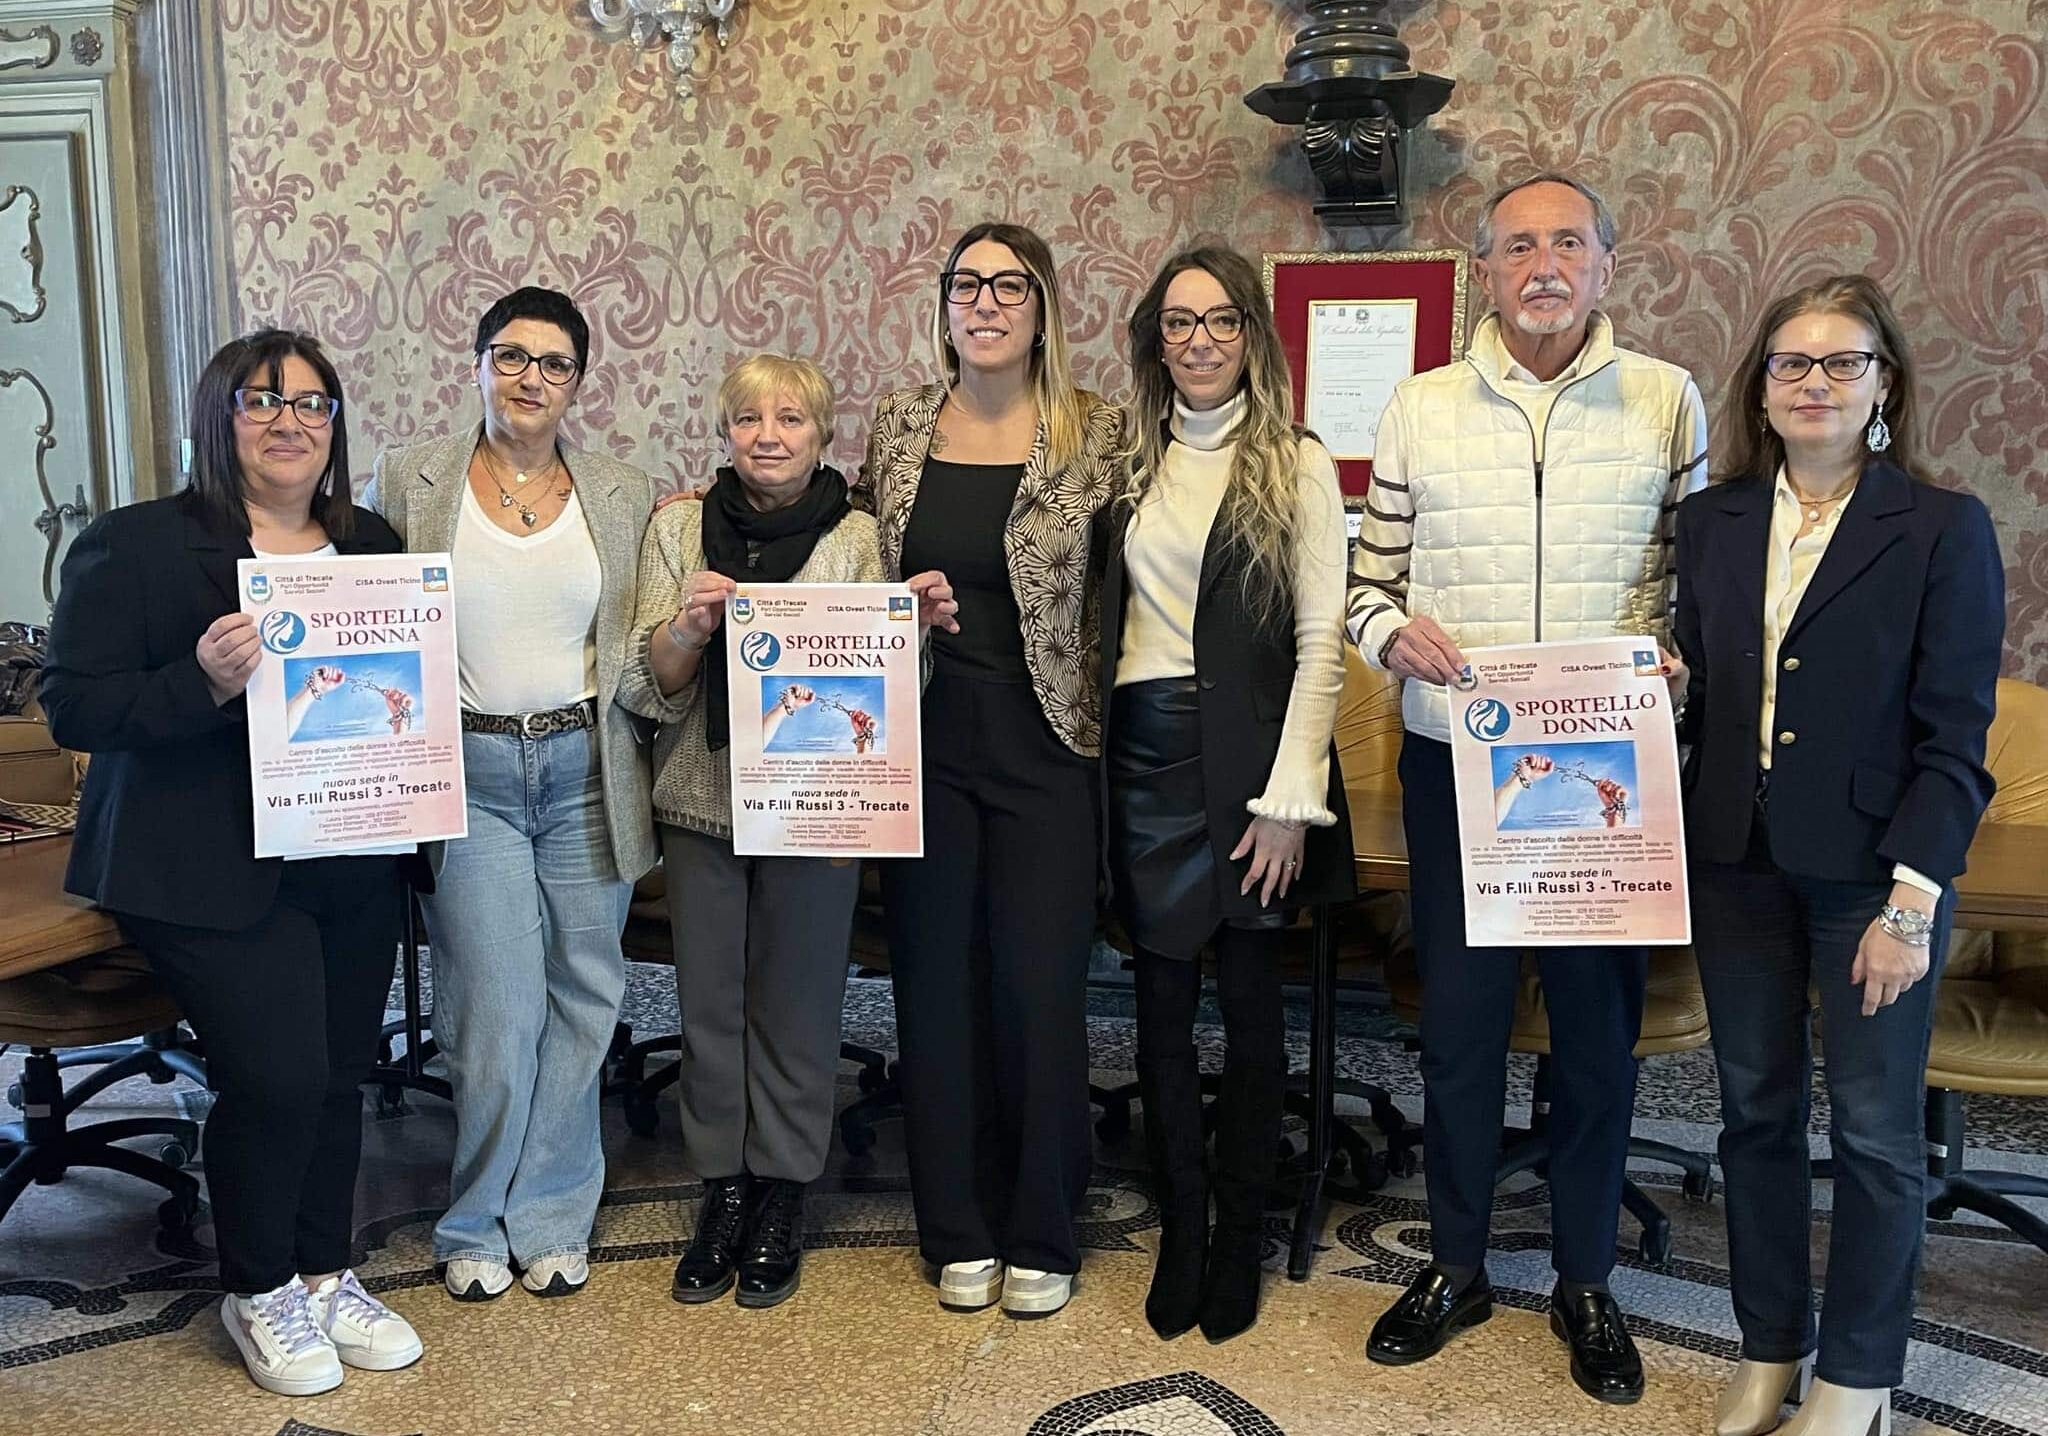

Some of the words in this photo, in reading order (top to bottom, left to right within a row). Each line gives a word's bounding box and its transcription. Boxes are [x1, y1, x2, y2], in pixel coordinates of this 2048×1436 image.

[310, 606, 442, 628] SPORTELLO
[336, 627, 420, 646] DONNA
[785, 635, 906, 650] SPORTELLO
[808, 653, 886, 668] DONNA
[1515, 692, 1657, 717] SPORTELLO
[1542, 716, 1634, 735] DONNA
[322, 778, 357, 789] nuova
[359, 774, 386, 786] sede
[388, 772, 399, 782] in
[267, 795, 292, 808] Via
[328, 787, 370, 802] Russi
[374, 786, 383, 798] 3
[397, 780, 452, 796] Trecate
[792, 790, 822, 798] nuova
[824, 789, 848, 798] sede
[850, 789, 860, 798] in
[743, 800, 764, 810] Via
[796, 800, 832, 812] Russi
[837, 800, 846, 812] 3
[858, 800, 910, 812] Trecate
[1532, 870, 1567, 879] nuova
[1570, 868, 1599, 878] sede
[1601, 868, 1613, 878] in
[1476, 883, 1501, 894] Via
[1538, 881, 1580, 894] Russi
[1586, 880, 1595, 892] 3
[1612, 880, 1673, 892] Trecate
